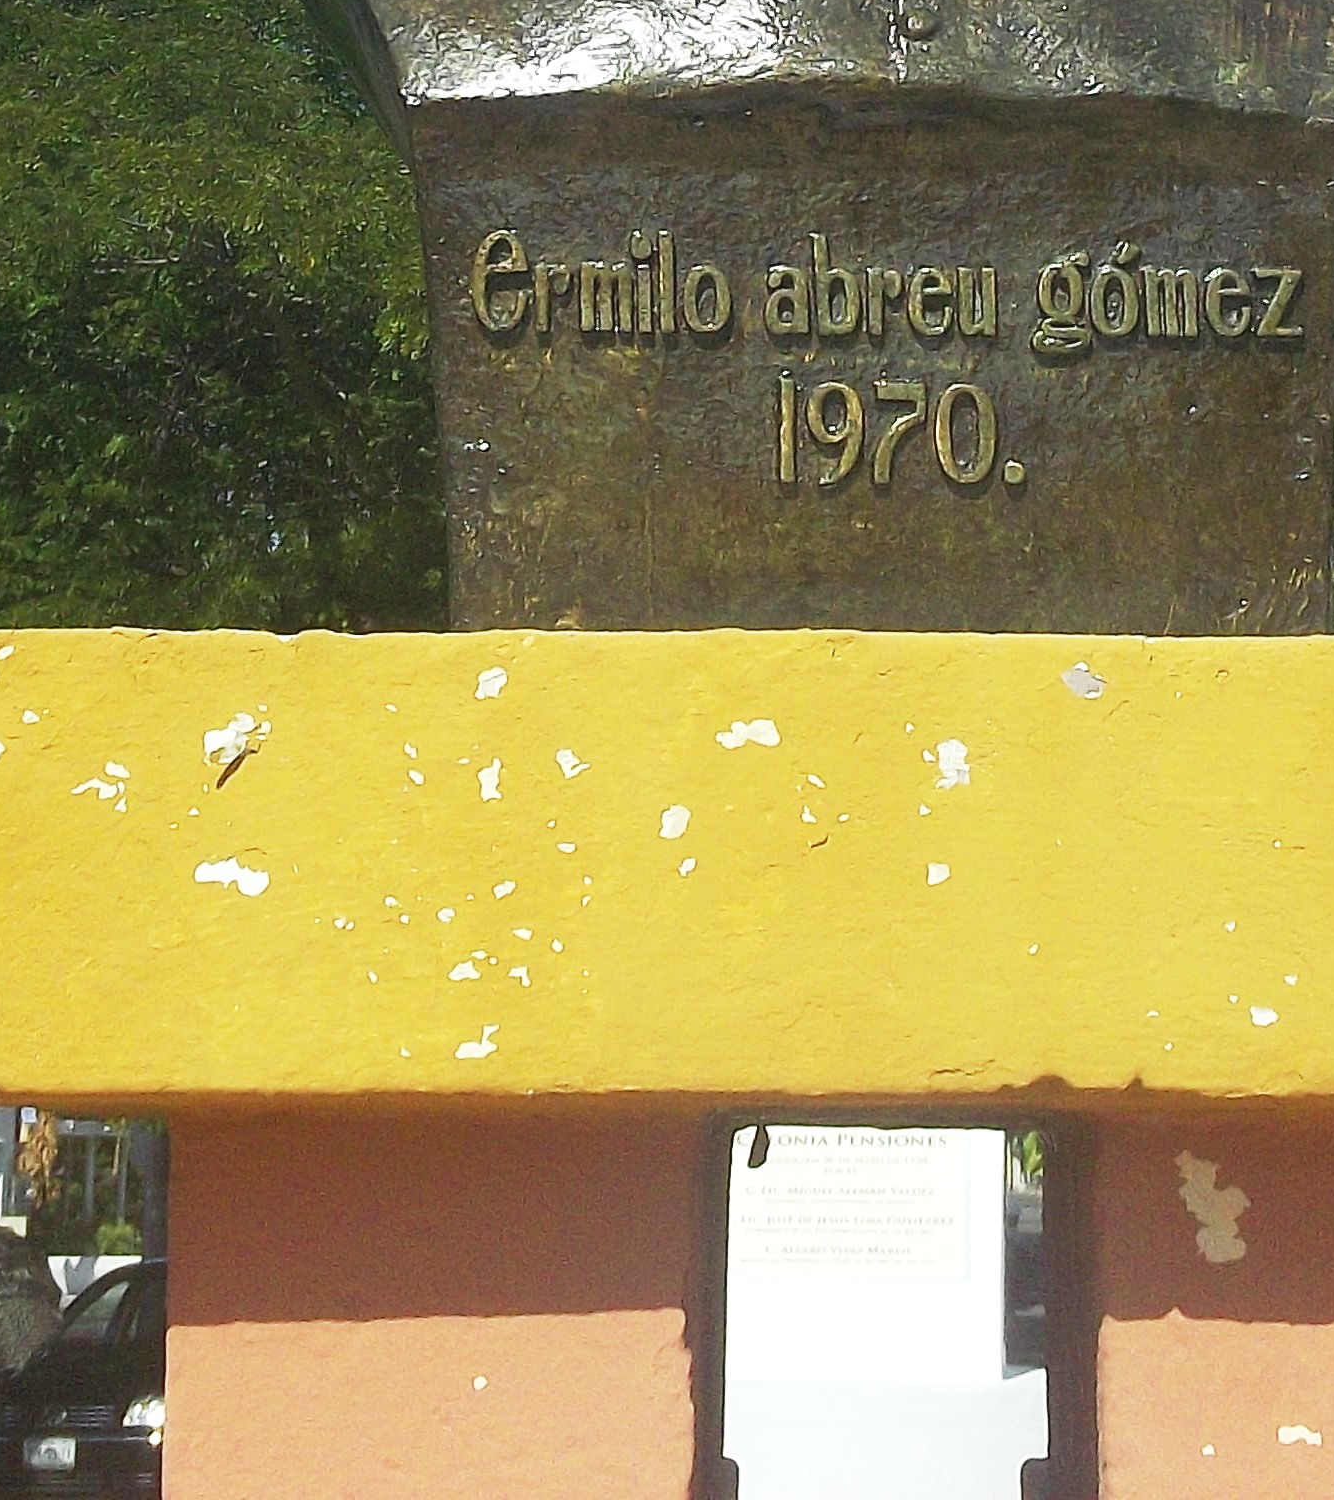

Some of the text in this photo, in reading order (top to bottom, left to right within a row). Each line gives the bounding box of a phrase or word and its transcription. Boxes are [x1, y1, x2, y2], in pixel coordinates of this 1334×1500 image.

[764, 231, 997, 337] abreu
[1031, 241, 1305, 355] gómez
[776, 368, 1027, 486] 1970.
[737, 1133, 947, 1147] CONIA PENSIONES
